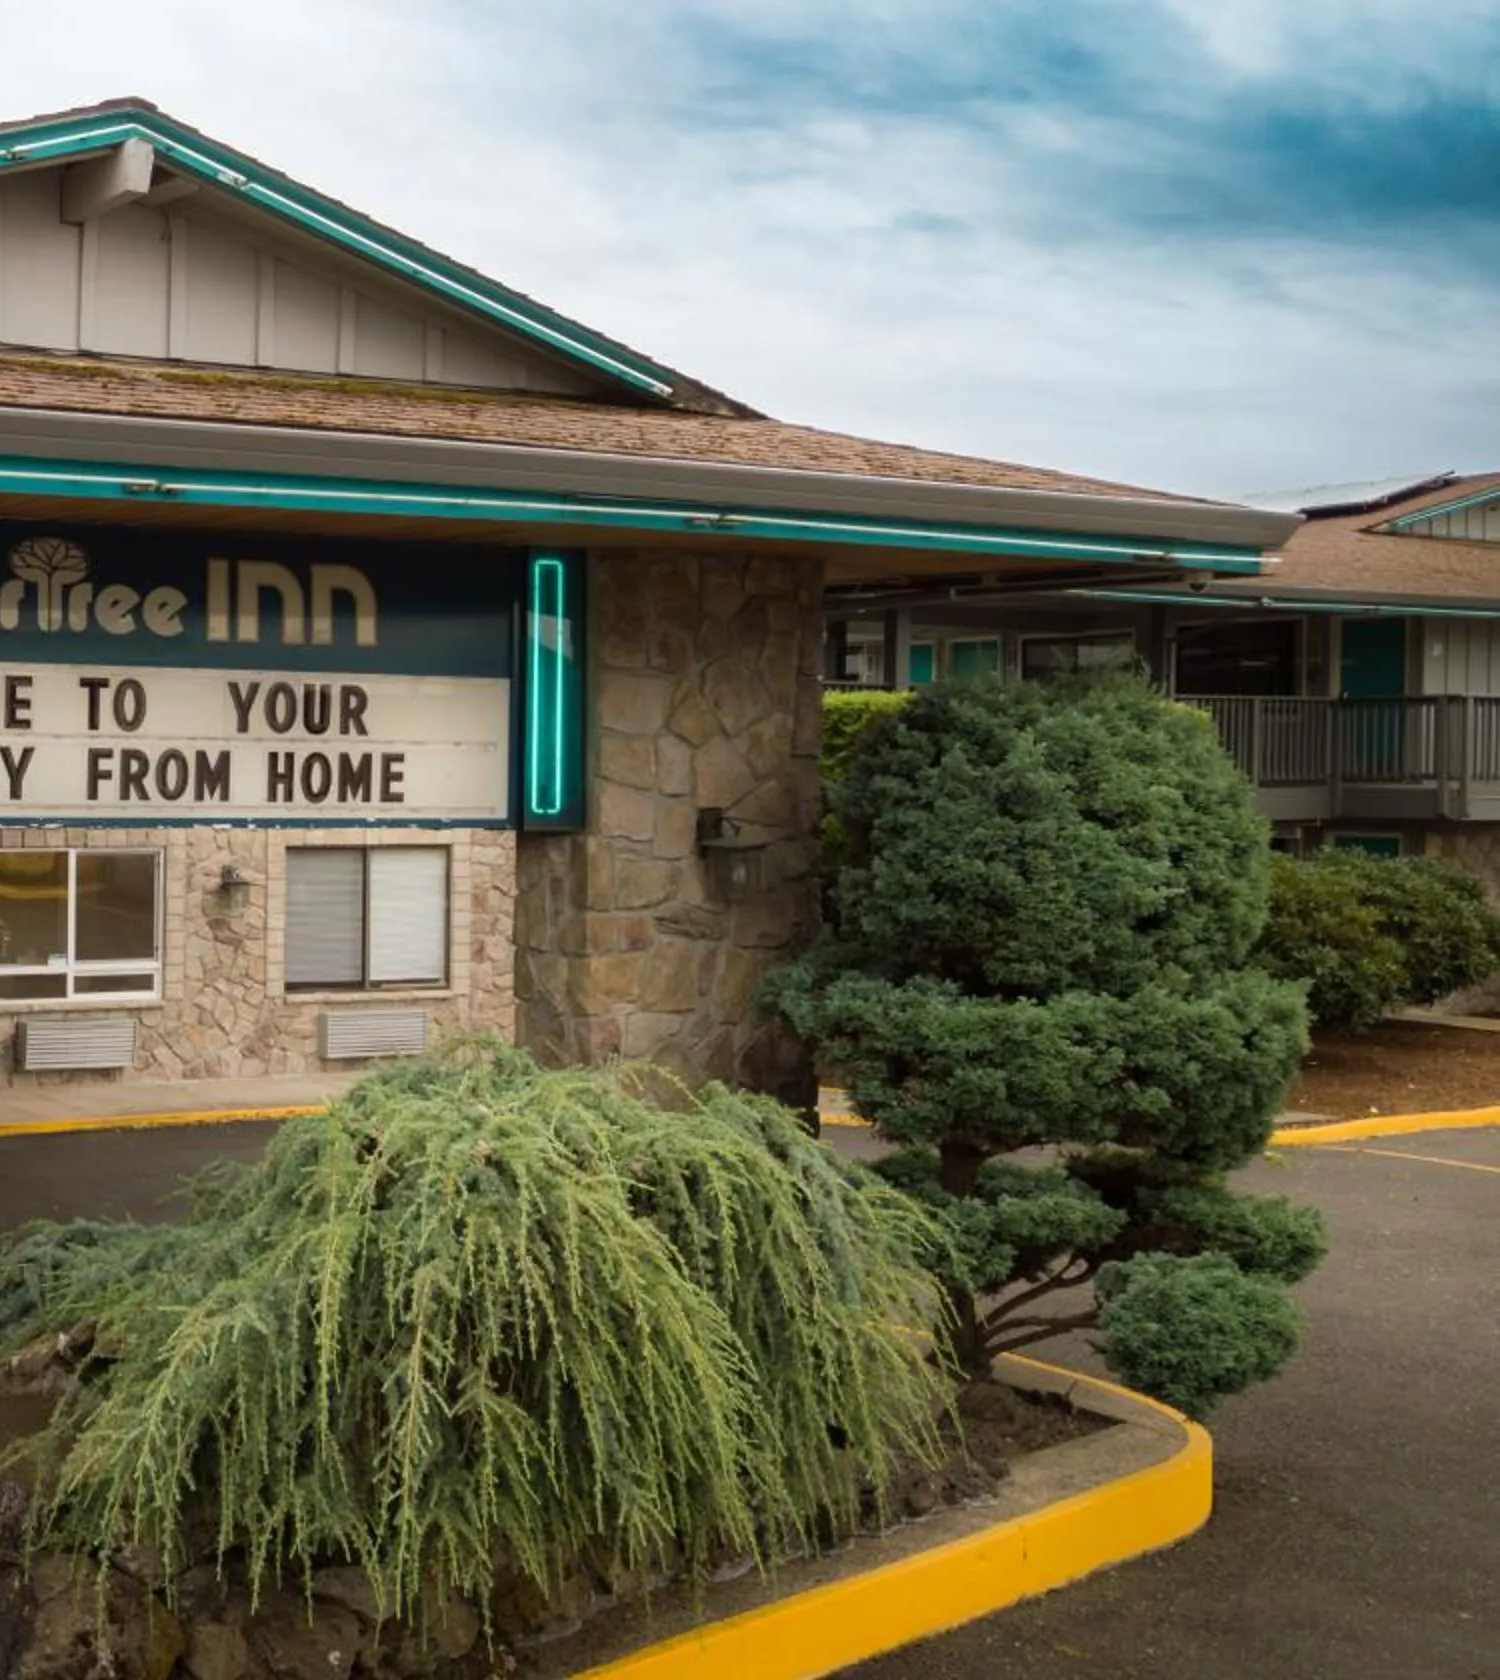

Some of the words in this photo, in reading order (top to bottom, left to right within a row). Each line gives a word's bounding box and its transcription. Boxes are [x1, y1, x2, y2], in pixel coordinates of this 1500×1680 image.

[78, 676, 147, 733] TO
[227, 681, 369, 737] YOUR
[87, 747, 231, 802] FROM
[267, 751, 405, 804] HOME
